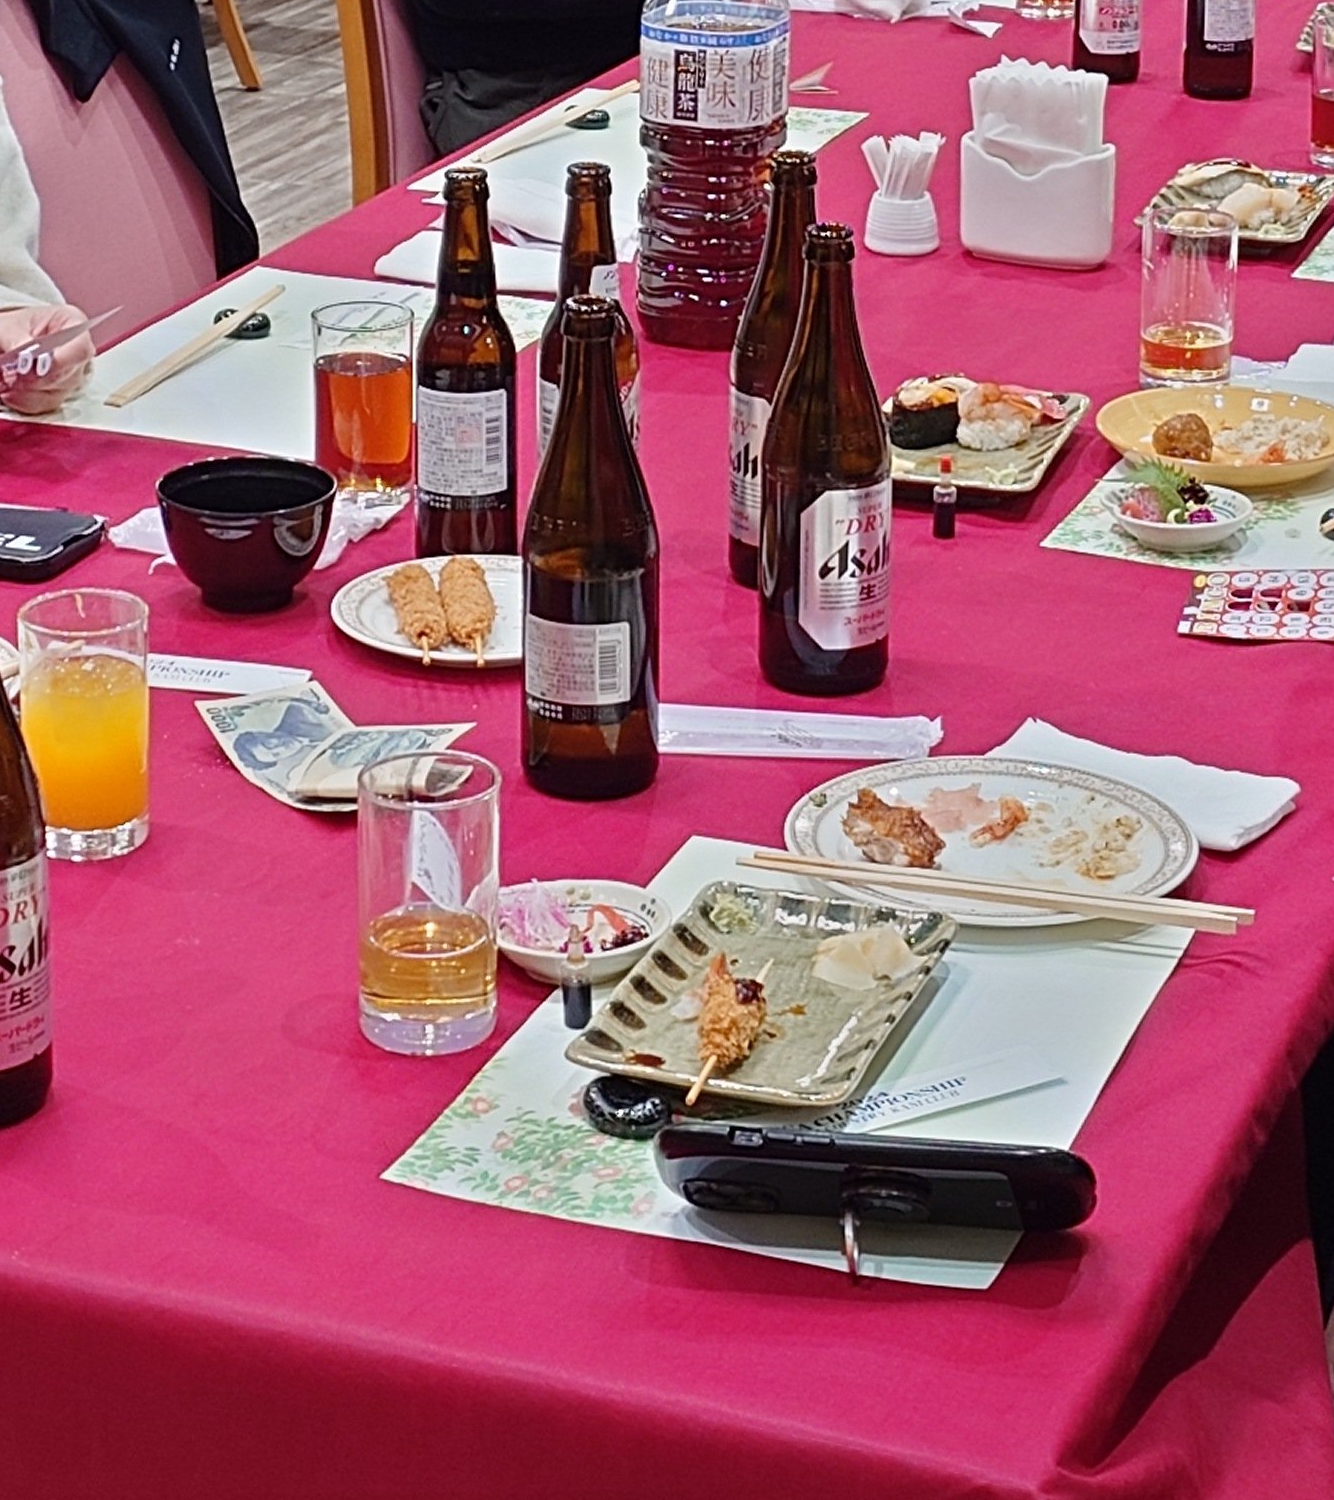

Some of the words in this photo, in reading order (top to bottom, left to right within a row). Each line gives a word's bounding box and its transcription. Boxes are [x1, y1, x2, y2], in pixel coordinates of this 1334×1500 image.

[707, 49, 736, 109] 美味
[818, 528, 891, 580] Asah
[859, 584, 877, 602] 生
[206, 706, 238, 733] 1000
[9, 987, 33, 1011] 生
